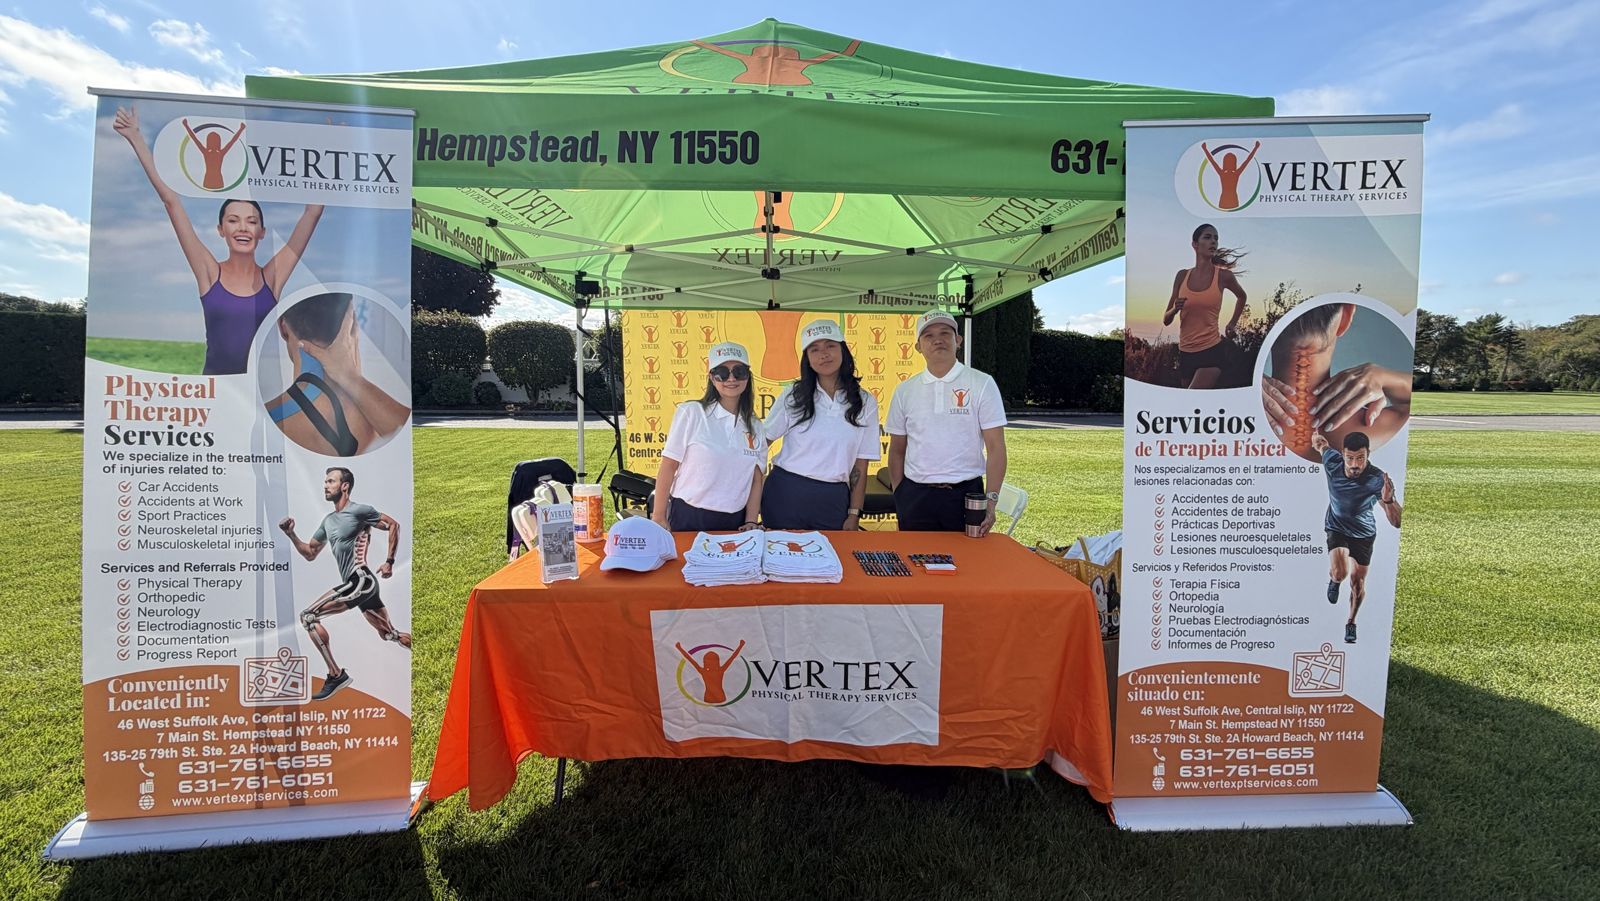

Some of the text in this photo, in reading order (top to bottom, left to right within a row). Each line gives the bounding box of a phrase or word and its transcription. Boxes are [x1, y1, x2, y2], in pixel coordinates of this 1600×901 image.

[417, 128, 760, 167] Hempstead, NY 11550
[1051, 139, 1126, 174] 631-
[249, 145, 398, 184] VERTEX
[1262, 159, 1407, 192] VERTEX
[248, 178, 400, 194] PHYSICAL THERAPY SERVICES
[1260, 192, 1408, 203] PHYSICAL THERAPY SERVICES
[104, 375, 216, 401] Physical
[104, 400, 211, 427] Therapy
[1136, 408, 1256, 435] Servicios
[104, 424, 214, 447] Services
[629, 433, 656, 443] 46 W.
[630, 448, 663, 458] Centra
[1135, 438, 1286, 460] de Terapia Física
[103, 451, 282, 464] We specialize in the treatment
[103, 464, 226, 476] of injuries related to:
[1134, 464, 1320, 476] Nos especializamos tratamiento de
[138, 482, 218, 492] Car Accidents
[1134, 478, 1170, 486] lesiones
[1172, 477, 1233, 486] relacionadas
[138, 496, 242, 506] Accidents Work
[1172, 494, 1269, 504] Accidentes de auto
[138, 510, 226, 523] Sport Practices
[1172, 507, 1280, 518] Accidentes de trabajo
[138, 525, 262, 537] Neuroskeletal injuries
[1172, 520, 1275, 530] Prácticas Deportivas
[1171, 532, 1311, 544] Lesiones neuroesqueletales
[138, 540, 274, 551] Musculoskeletal injuries
[1170, 545, 1323, 556] Lesiones musculoesqueletales
[100, 562, 289, 574] Services and Referrals Provided
[1132, 563, 1275, 572] Servicios Referidos Provistos:
[138, 577, 242, 590] Physical Therapy
[1170, 579, 1206, 590] Terapia
[138, 592, 205, 606] Orthopedic
[1169, 591, 1220, 603] Ortopedia
[138, 606, 200, 619] Neurology
[138, 618, 276, 632] Electrodiagnostic Tests
[1168, 615, 1310, 627] Pruebas Electrodiagnósticas
[1168, 628, 1246, 638] Documentación
[138, 635, 229, 646] Documentation
[1168, 640, 1275, 651] Informes de Progreso
[138, 648, 237, 662] Progress Report
[751, 660, 918, 690] VERTEX
[1128, 670, 1260, 685] Convenientemente
[108, 674, 229, 694] Conveniently
[752, 690, 916, 702] PHYSICAL THERAPY SERVICES
[1127, 686, 1204, 702] situado en:
[108, 693, 210, 712] Located in:
[1140, 704, 1354, 716] 46 West Suffolk Ave, Central Islip, NY 11722
[118, 708, 386, 730] 46 West Suffolk Ave, Central Islip, NY 11722
[1178, 718, 1325, 730] Main St. Hempstead NY 11550
[168, 724, 350, 743] Main St. Hempstead NY 11550
[1130, 731, 1364, 744] 135-25 79th St. Ste. 2A Howard Beach, NY 11414
[103, 736, 399, 762] 135-25 79th St. Ste. 2A Howard Beach, NY 11414
[1180, 747, 1314, 760] 631-761-6655
[178, 754, 332, 775] 631-761-6655
[1180, 764, 1314, 778] 631-761-6051
[178, 772, 333, 793] 631-761-6051
[1174, 778, 1318, 790] www.vertexptservices.com
[172, 788, 338, 807] www.vertexptservices.com
